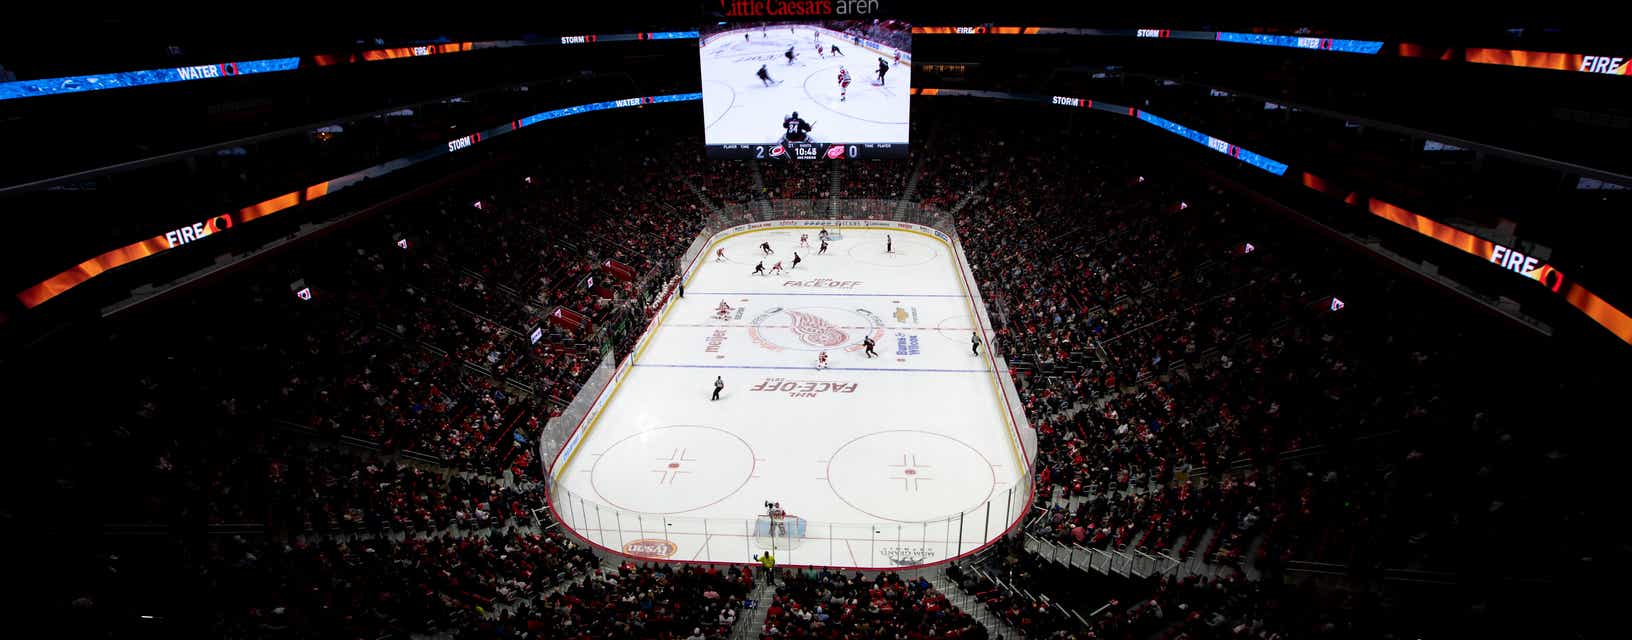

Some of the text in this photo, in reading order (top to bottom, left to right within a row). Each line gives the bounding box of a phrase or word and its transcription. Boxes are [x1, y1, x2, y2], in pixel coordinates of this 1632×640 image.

[766, 0, 832, 15] Caesars
[836, 0, 879, 14] aren
[955, 26, 974, 35] FIRE
[1137, 28, 1159, 38] STORM
[561, 35, 585, 45] STORM
[1297, 36, 1320, 50] WATER
[413, 46, 429, 57] FIRE
[177, 63, 220, 81] WATER
[1580, 55, 1623, 75] FIRE
[615, 96, 640, 108] WATER
[1052, 96, 1079, 107] STORM
[448, 136, 471, 152] STORM
[1208, 135, 1229, 155] WATER
[756, 145, 765, 159] 2
[848, 145, 858, 158] 0
[165, 222, 207, 249] FIRE
[1490, 244, 1539, 278] FIRE
[749, 381, 858, 393] FACE-OFF
